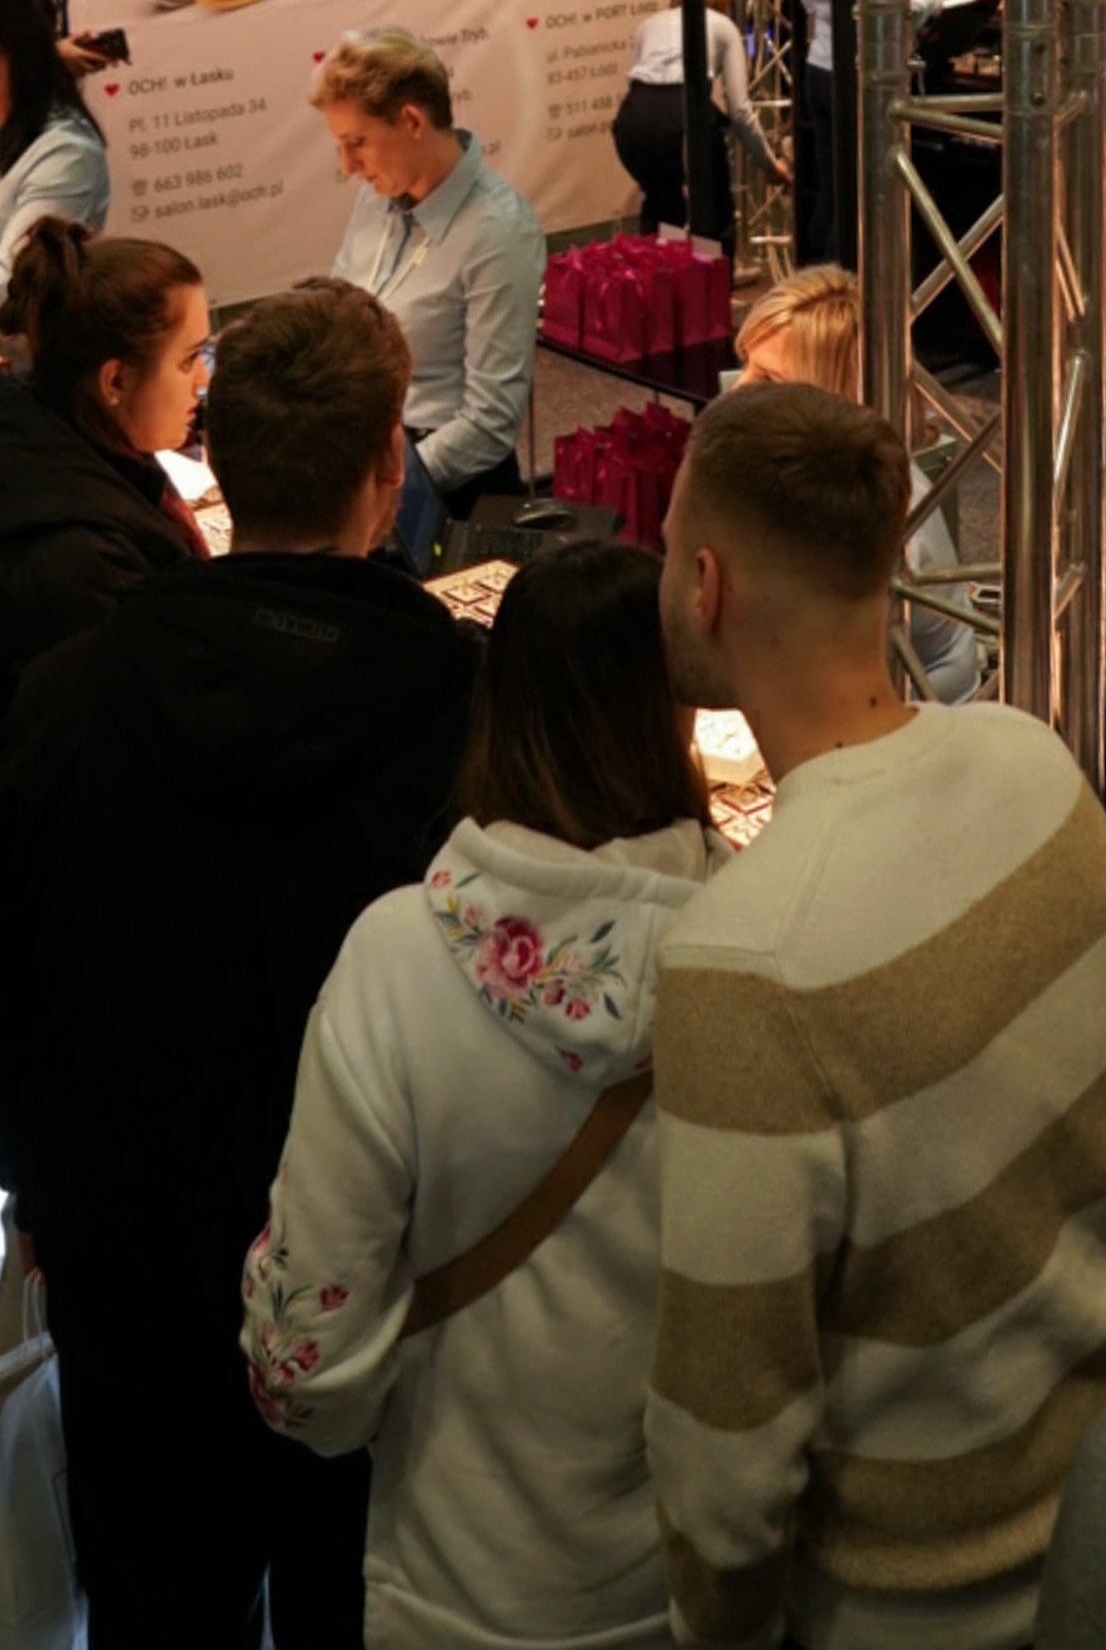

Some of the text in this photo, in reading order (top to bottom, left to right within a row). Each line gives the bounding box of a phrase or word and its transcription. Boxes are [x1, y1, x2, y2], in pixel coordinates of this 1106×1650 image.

[128, 76, 167, 95] OCH!
[174, 77, 186, 88] w
[153, 114, 170, 129] 11
[174, 102, 246, 127] Listopada
